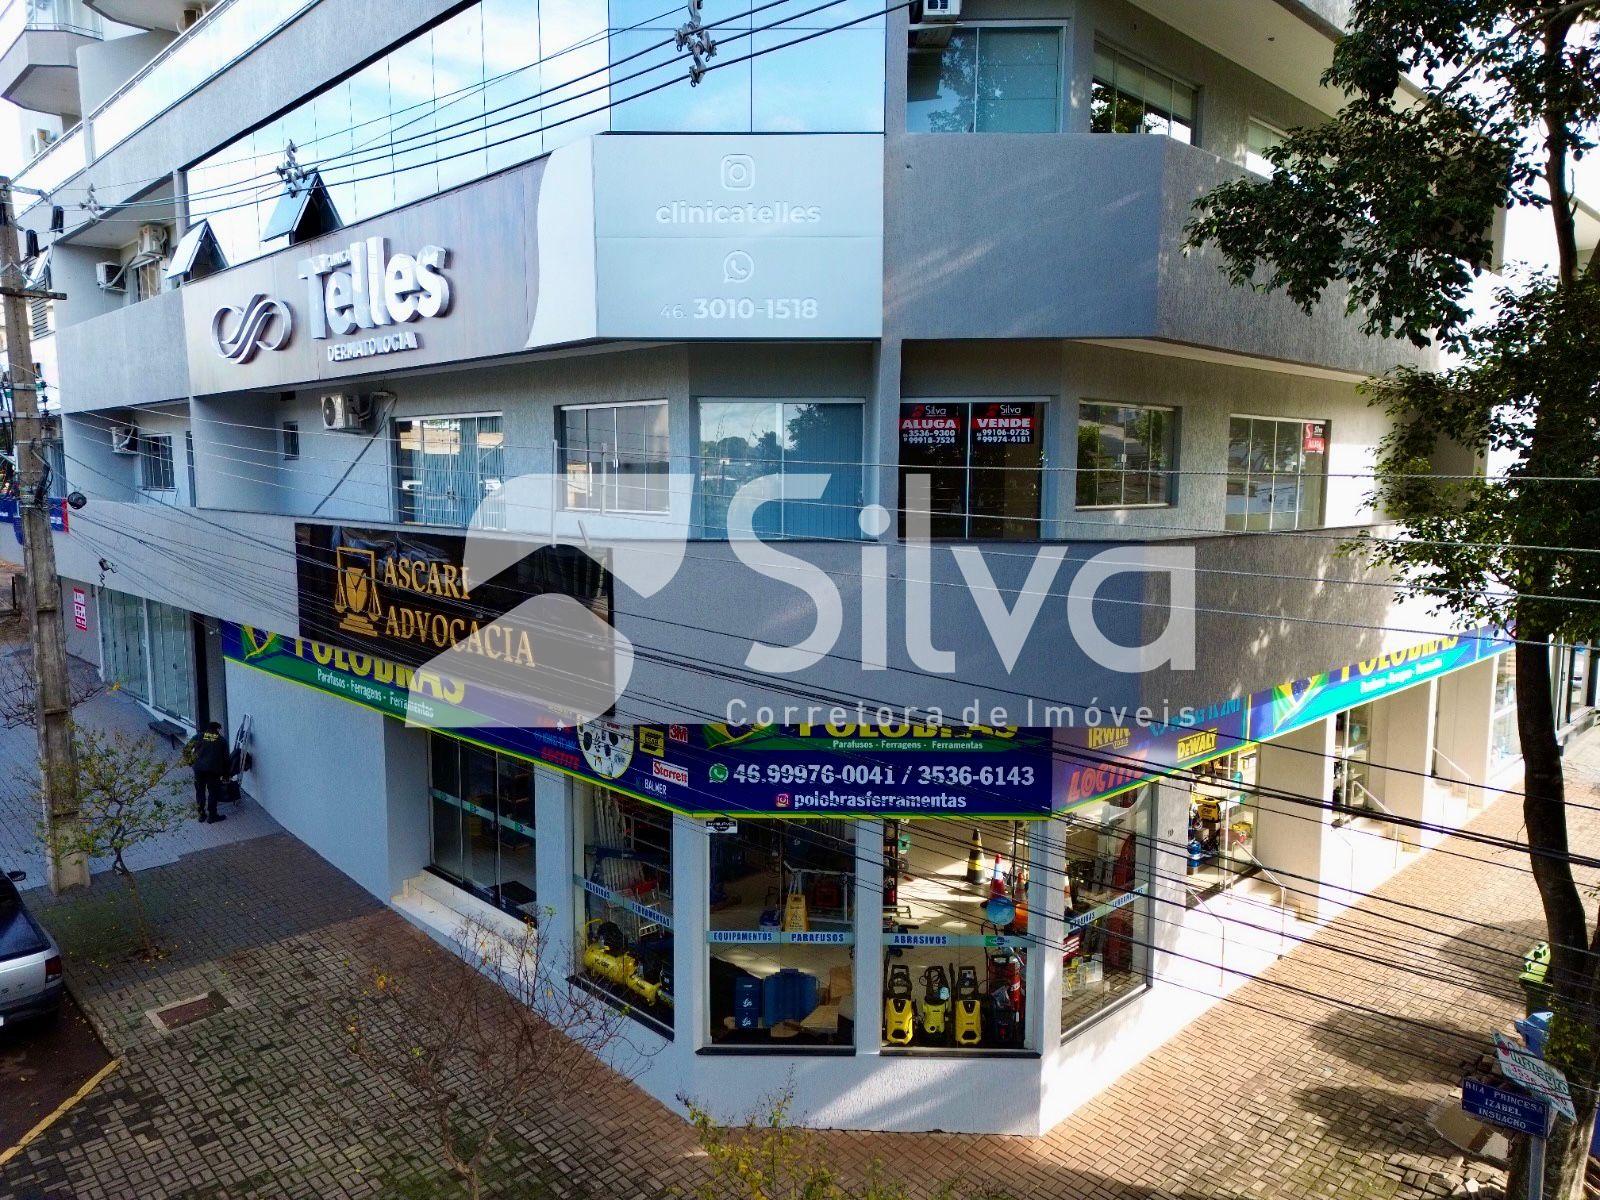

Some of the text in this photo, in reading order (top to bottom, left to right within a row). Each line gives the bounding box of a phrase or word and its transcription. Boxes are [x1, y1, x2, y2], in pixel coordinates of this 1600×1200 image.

[655, 200, 822, 225] clinicatelles
[298, 237, 450, 339] Telles
[693, 297, 818, 320] 3010-1518
[925, 404, 947, 415] Silva
[1000, 403, 1021, 414] Silva
[902, 419, 957, 429] ALUGA
[977, 418, 1031, 428] VENDE
[384, 556, 471, 600] ASCARI
[385, 605, 536, 667] ADVOCACIA
[317, 668, 346, 689] Parafusos
[351, 679, 382, 702] Ferragens
[833, 740, 873, 749] Parafusos
[881, 740, 921, 751] Ferragens
[932, 740, 984, 750] Ferramentas
[653, 761, 688, 784] Starrett
[732, 764, 896, 785] 46.99976-0041
[917, 765, 1035, 786] 3536-6143
[794, 791, 967, 809] polobrasferramentas
[713, 931, 844, 943] EQUIPAMENTOS PARAFUSOS
[894, 935, 947, 945] ABRASIVOS
[1465, 1080, 1485, 1095] RUA
[1493, 1091, 1544, 1114] PRINCESA
[1484, 1097, 1522, 1116] IZABEL
